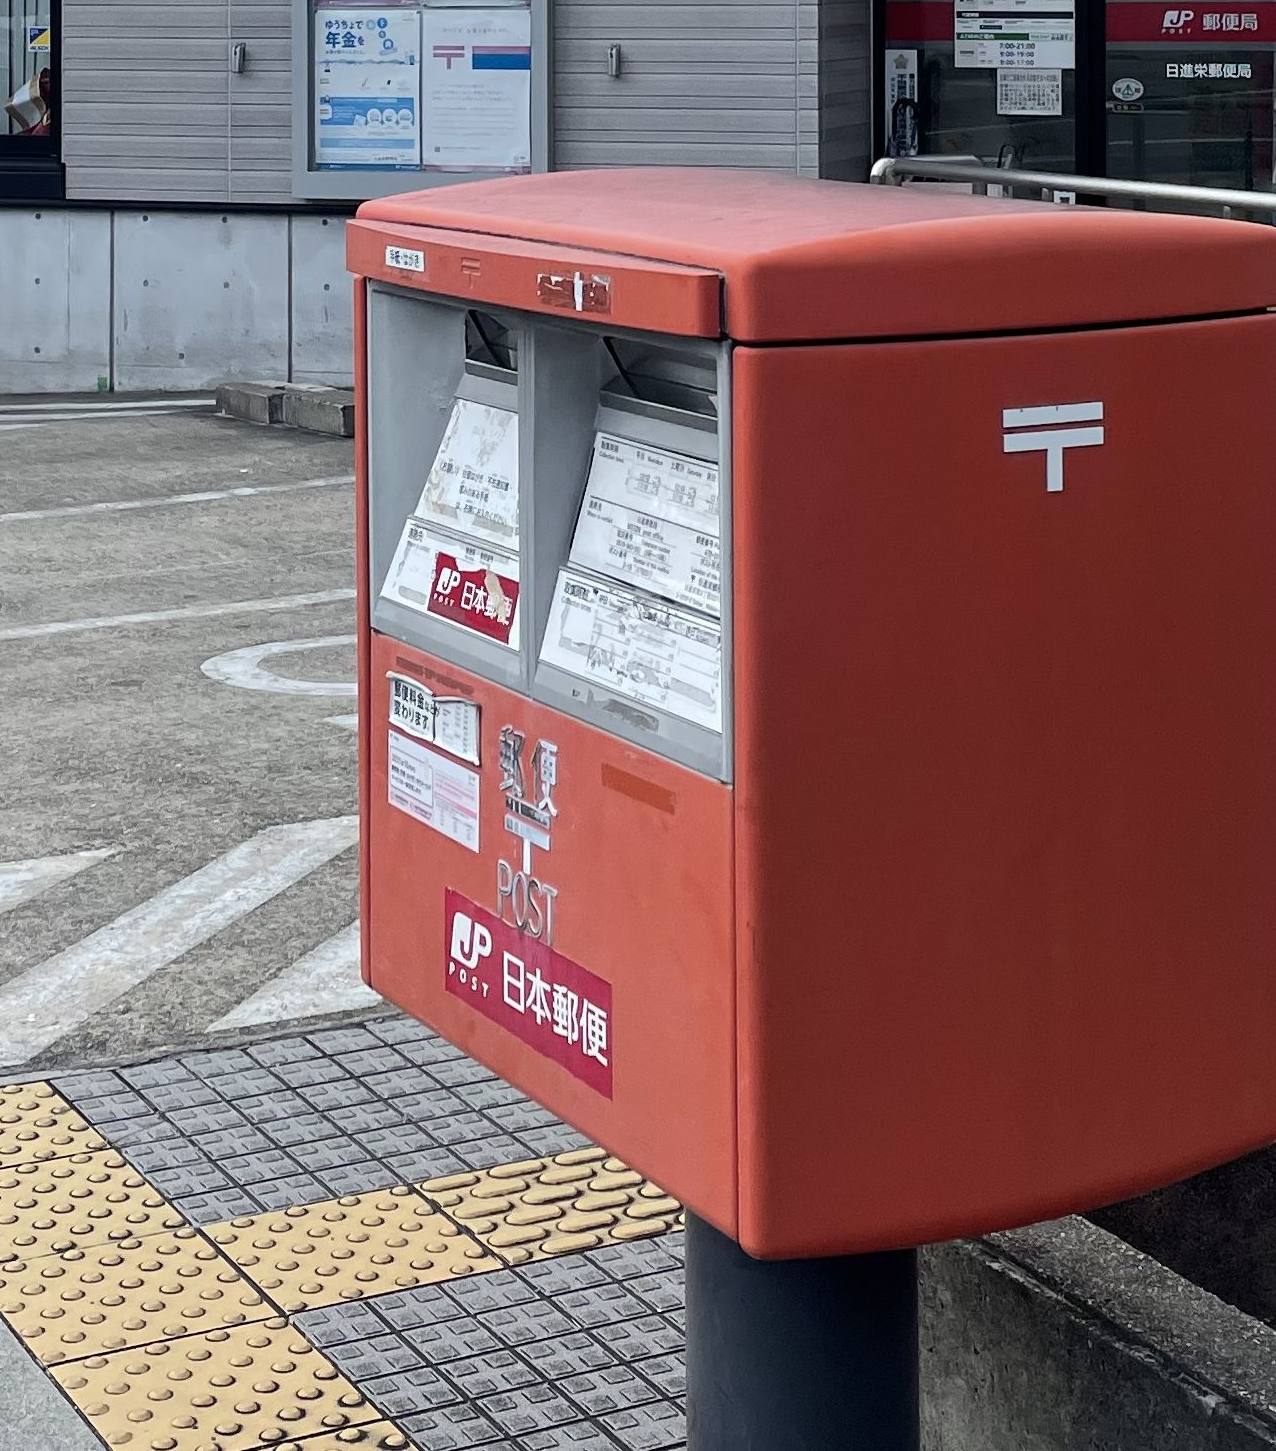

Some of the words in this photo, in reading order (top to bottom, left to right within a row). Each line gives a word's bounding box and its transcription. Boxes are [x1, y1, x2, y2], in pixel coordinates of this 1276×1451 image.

[325, 20, 364, 30] ゆうちょで
[1202, 13, 1258, 31] 郵便局
[325, 31, 365, 48] 年金を
[1166, 63, 1252, 79] 日進栄郵便局
[497, 858, 558, 947] POST
[450, 911, 492, 970] JP
[448, 961, 490, 999] POST
[502, 949, 609, 1068] 日本郵便
